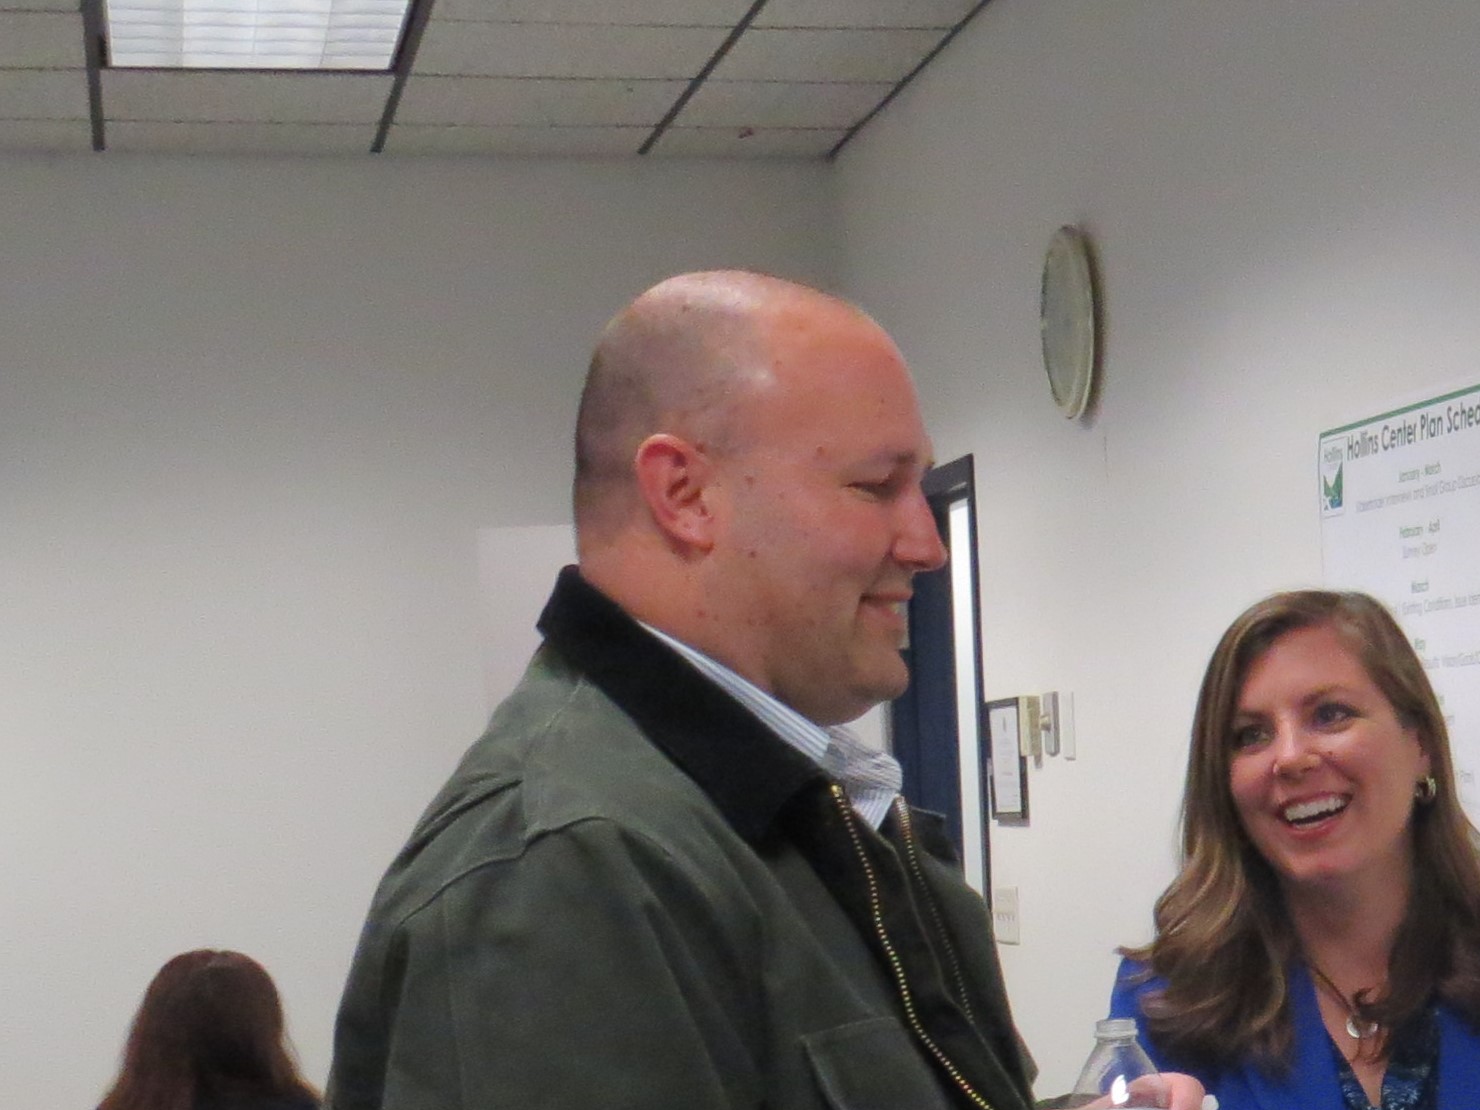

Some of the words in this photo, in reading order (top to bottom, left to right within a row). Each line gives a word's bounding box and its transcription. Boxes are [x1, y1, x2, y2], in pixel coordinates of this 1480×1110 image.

[1347, 434, 1379, 462] Hollins
[1381, 422, 1417, 452] Center
[1420, 412, 1443, 442] Plan
